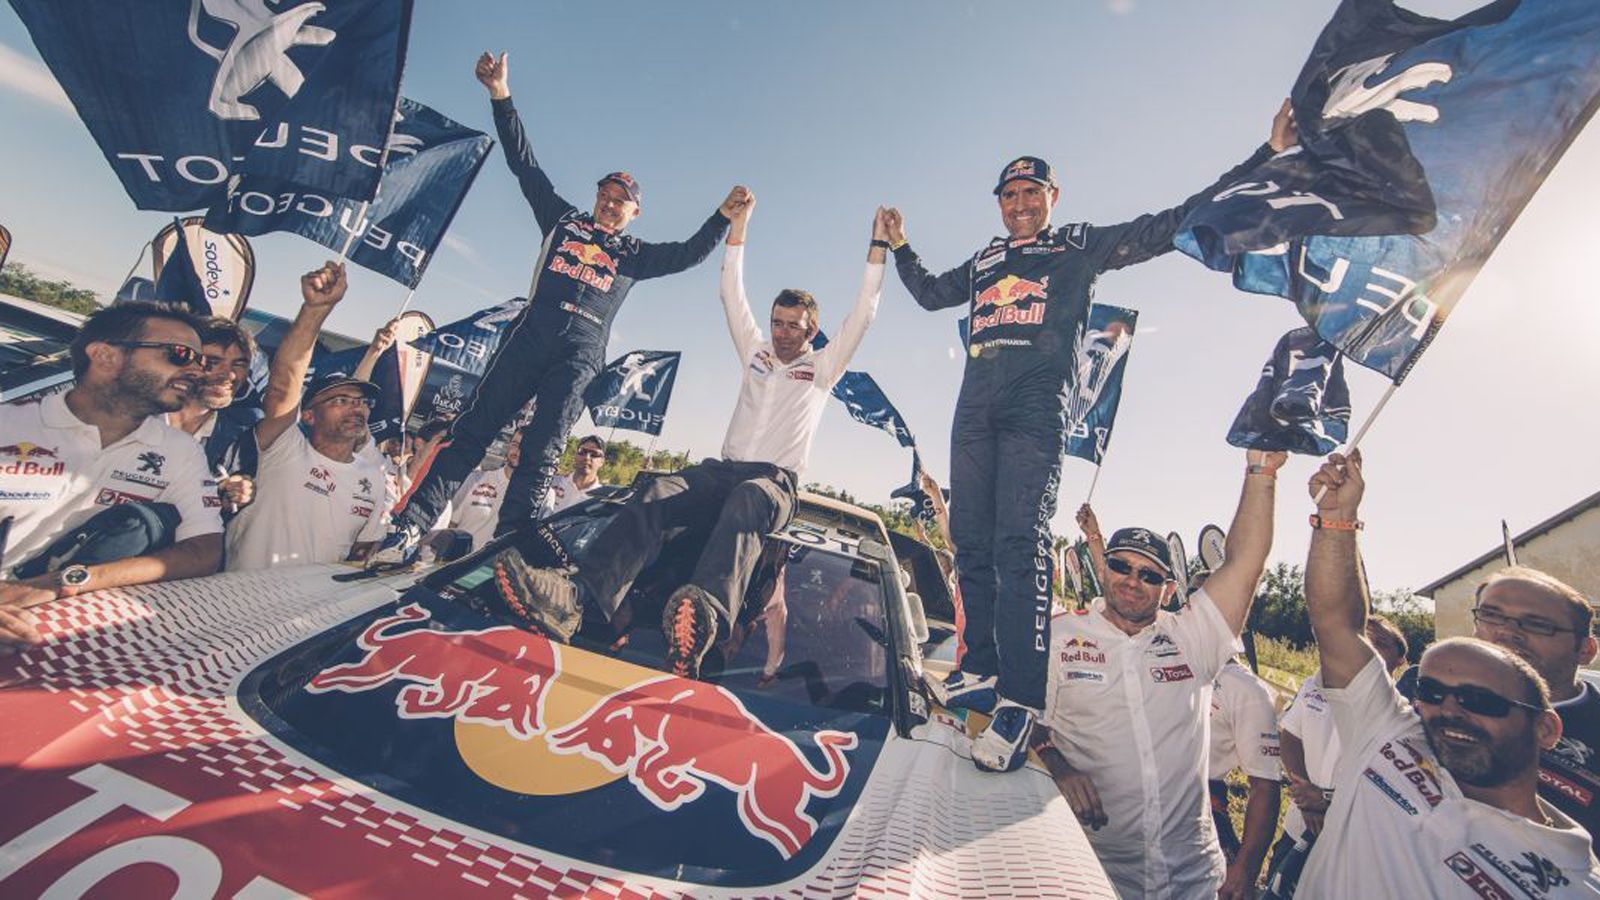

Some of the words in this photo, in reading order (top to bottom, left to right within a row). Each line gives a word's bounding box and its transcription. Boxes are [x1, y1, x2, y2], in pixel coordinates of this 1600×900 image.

[205, 240, 222, 299] sodexo
[548, 255, 583, 279] Red
[580, 266, 614, 293] Bull
[1000, 302, 1046, 325] Bull
[0, 461, 21, 475] ed
[23, 461, 65, 476] Bull
[1061, 651, 1081, 662] Red
[1082, 652, 1106, 664] Bull
[1537, 770, 1588, 802] OTAL
